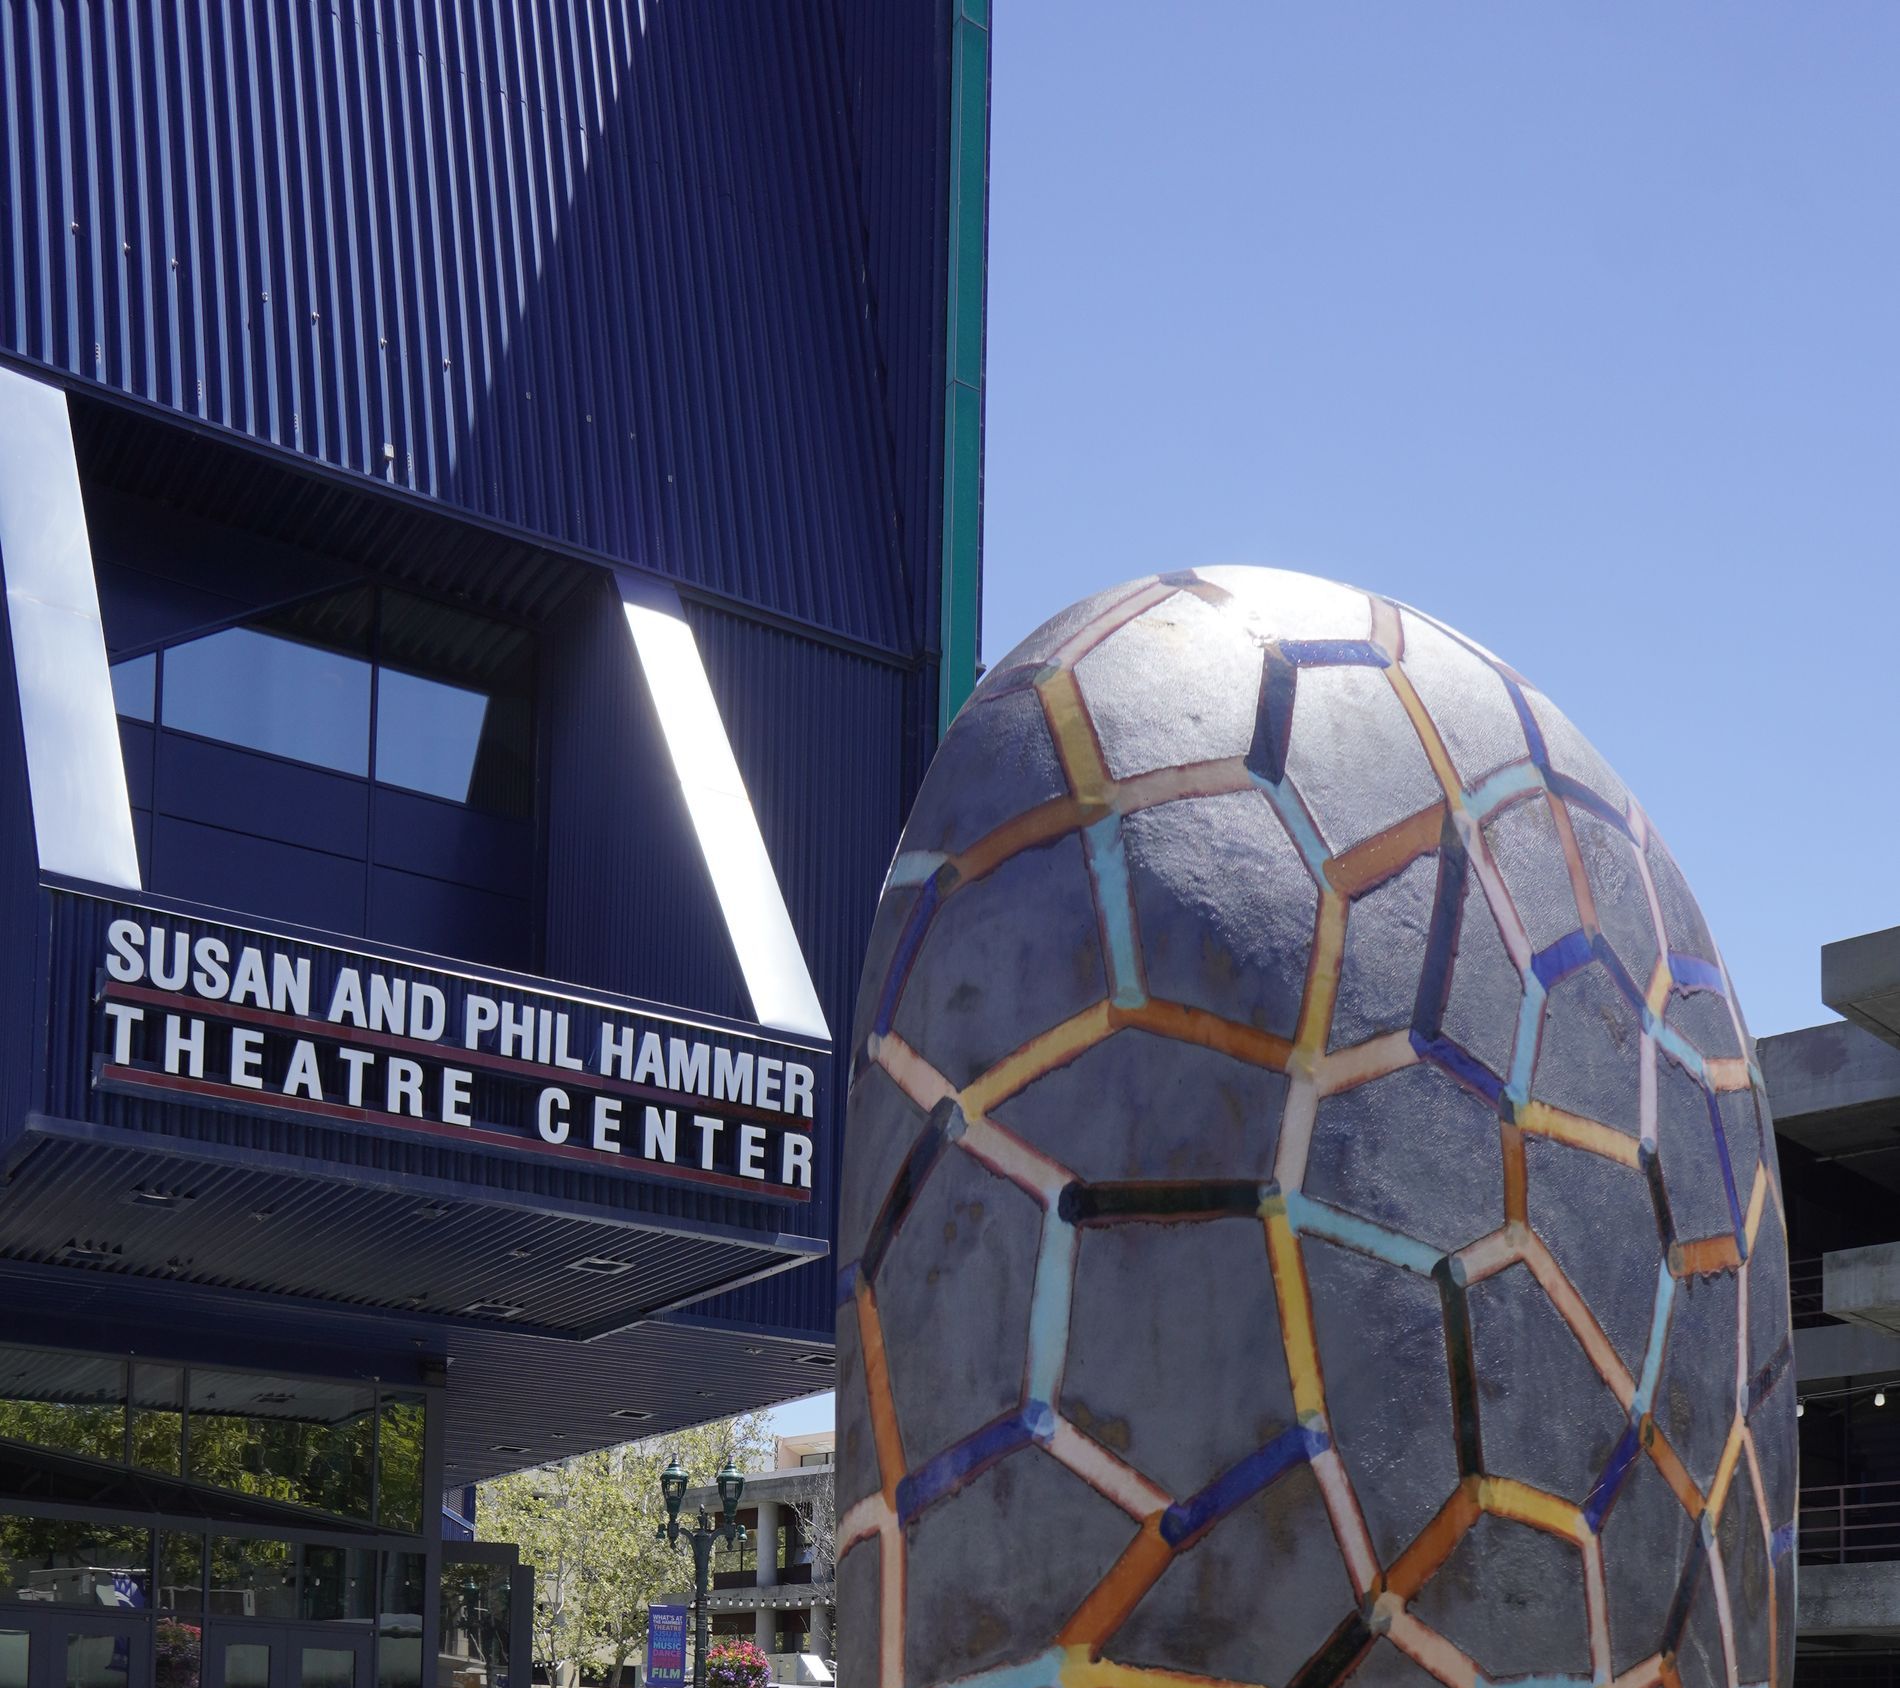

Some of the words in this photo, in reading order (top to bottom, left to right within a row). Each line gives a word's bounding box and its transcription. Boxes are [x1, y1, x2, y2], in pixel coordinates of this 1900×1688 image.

[106, 919, 310, 1016] SUSAN
[328, 967, 446, 1041] AND
[465, 994, 583, 1071] PHIL
[600, 1022, 814, 1118] HAMMER
[105, 1002, 472, 1127] THEATRE
[538, 1087, 812, 1188] CENTER
[653, 1641, 681, 1649] MUSIC
[653, 1649, 681, 1657] DANCE
[652, 1667, 680, 1678] FILM
